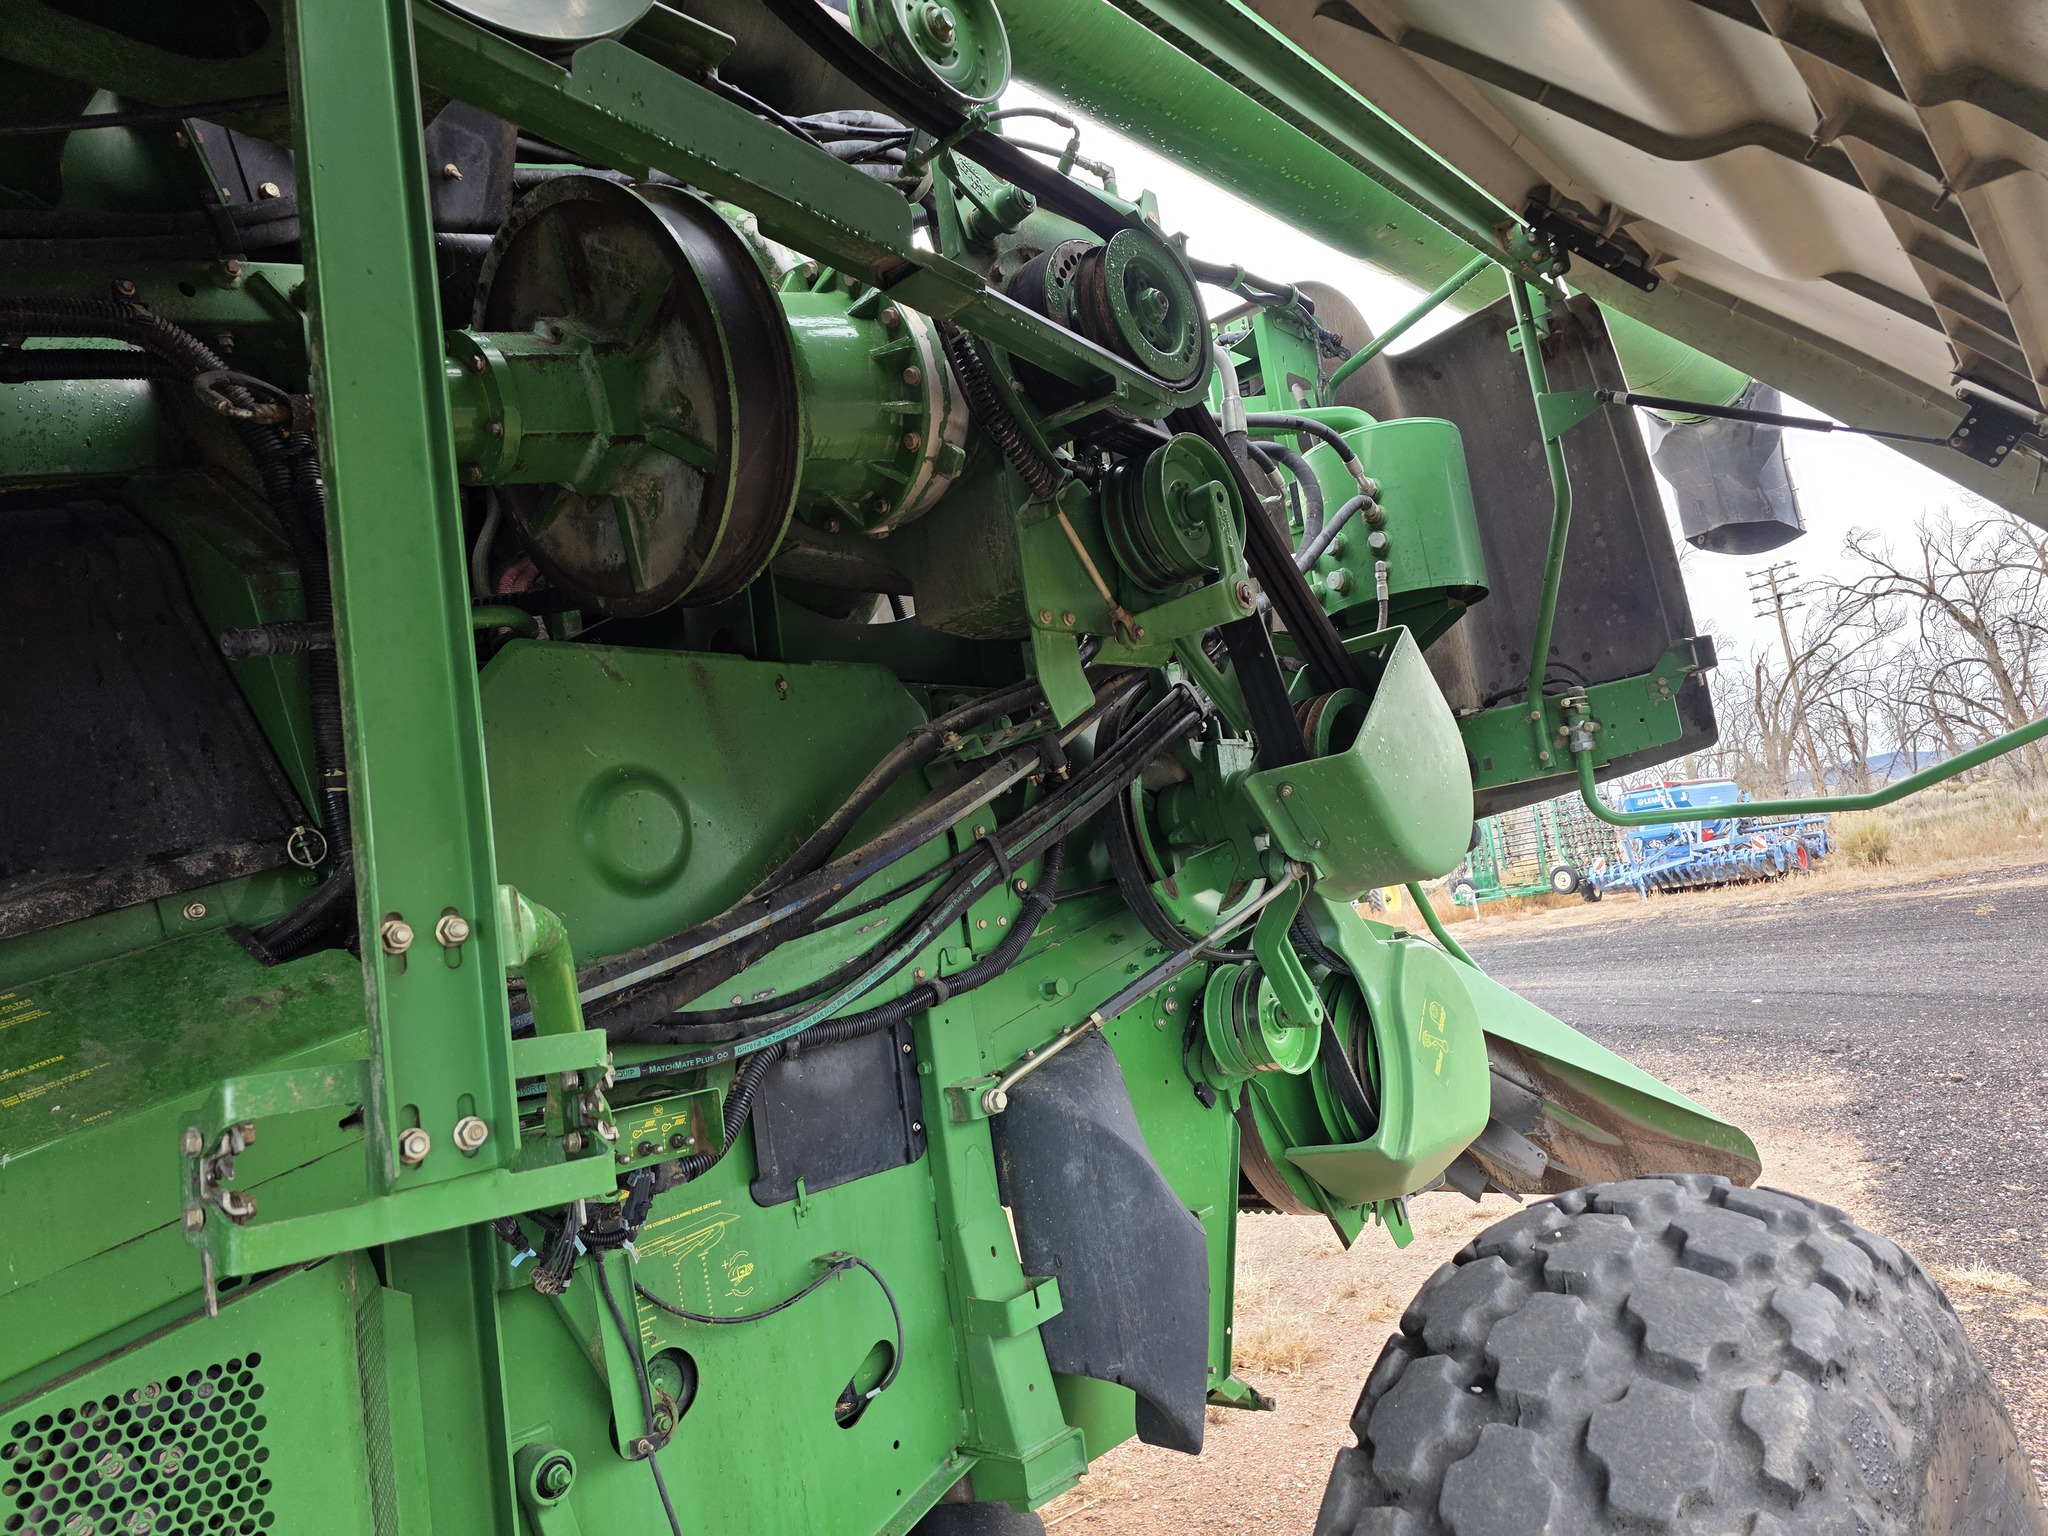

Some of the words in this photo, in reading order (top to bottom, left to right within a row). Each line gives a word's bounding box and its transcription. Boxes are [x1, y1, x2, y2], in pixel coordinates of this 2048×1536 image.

[812, 1012, 825, 1022] BAR
[28, 1054, 65, 1069] SYSTEM
[696, 1055, 714, 1066] PLUS
[671, 1209, 691, 1220] CLEANING
[691, 1205, 703, 1213] SHOE
[702, 1199, 721, 1209] SETTINGS
